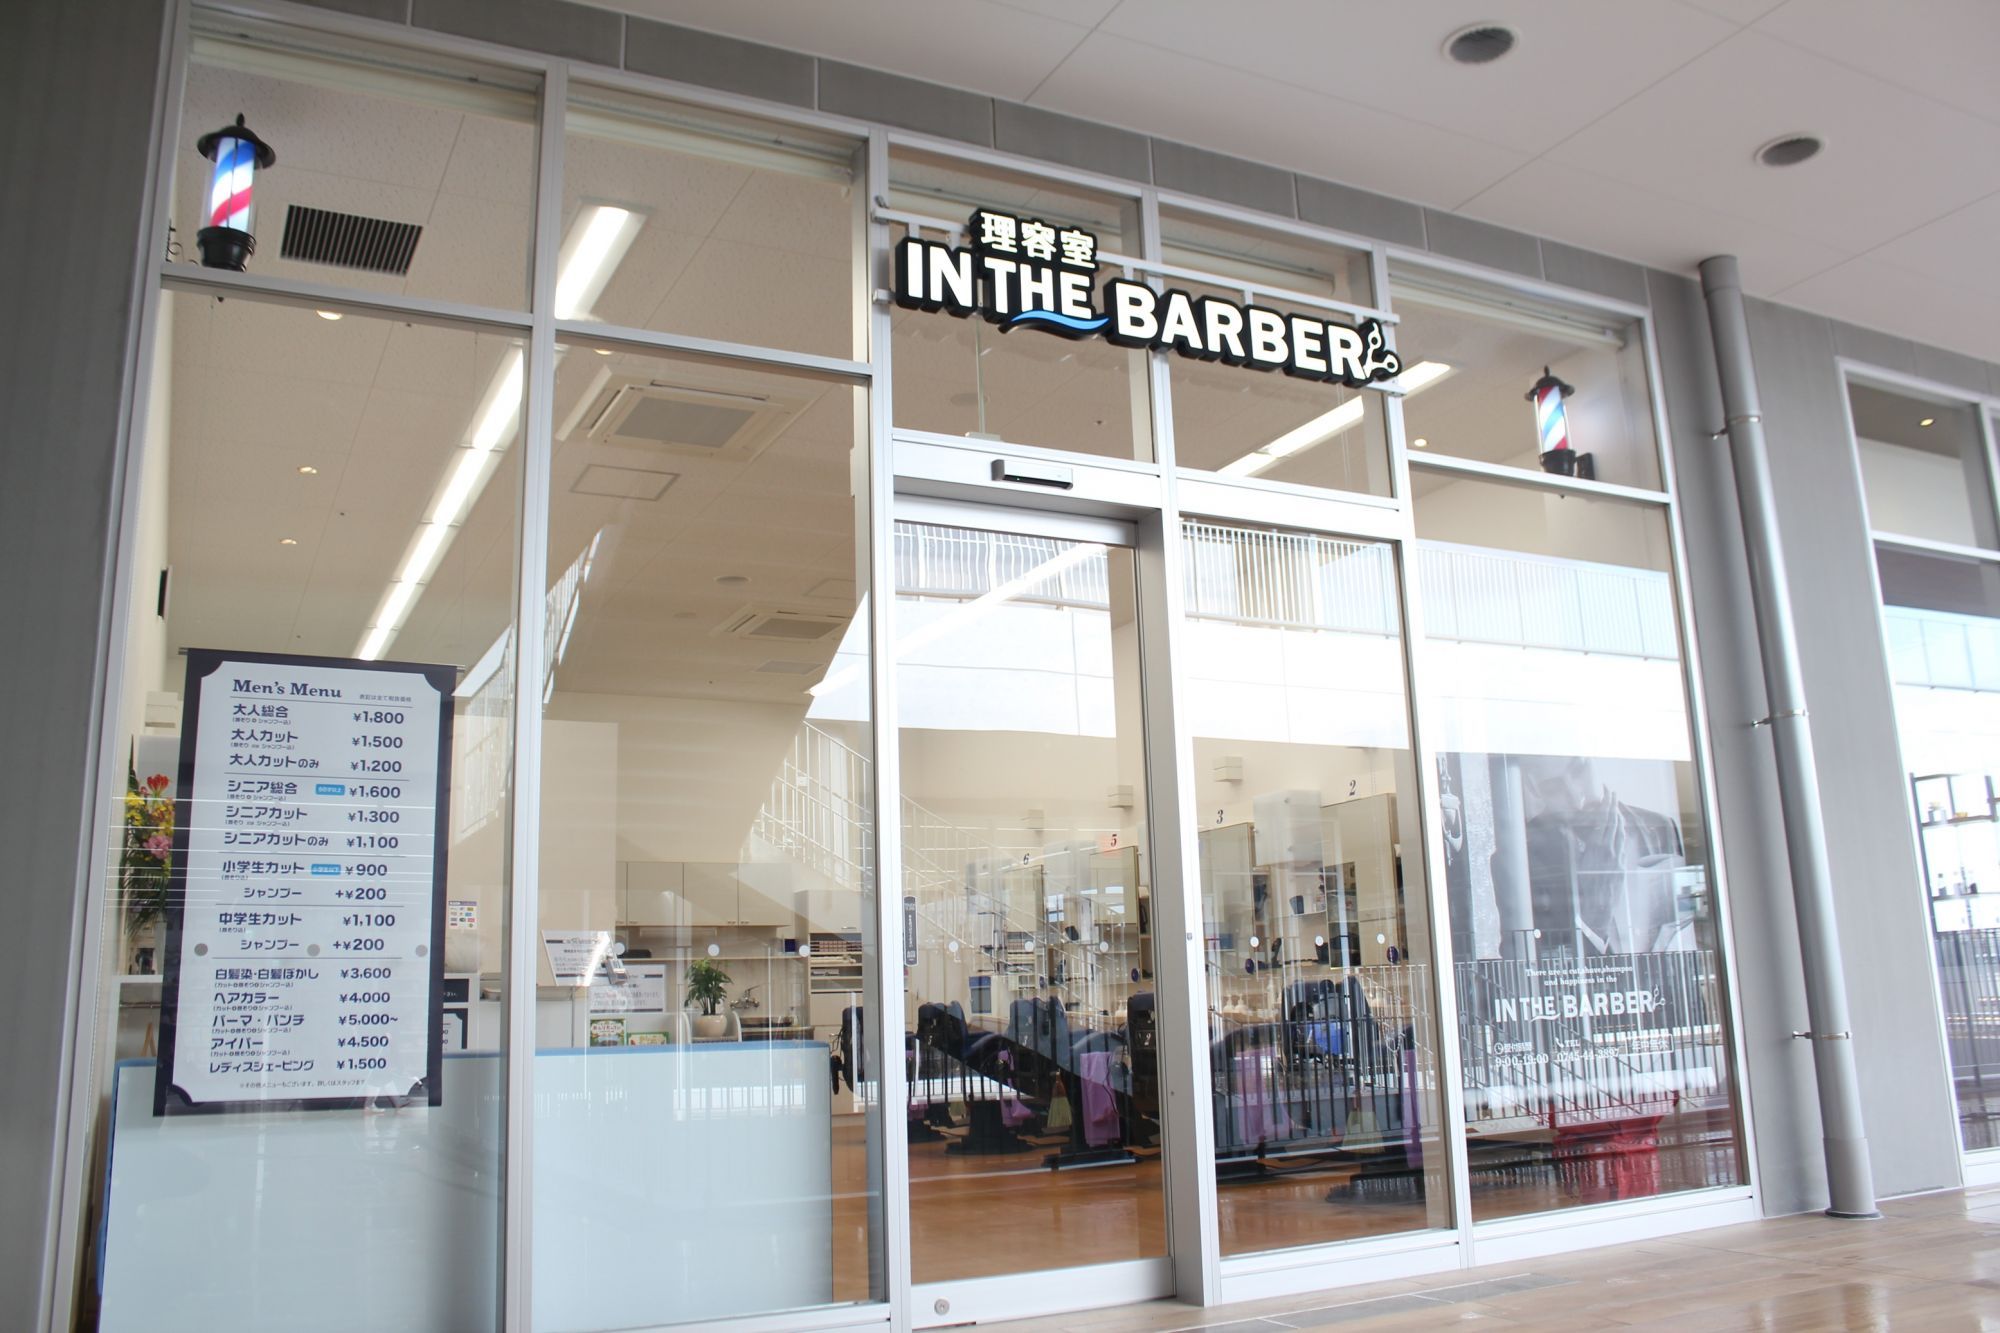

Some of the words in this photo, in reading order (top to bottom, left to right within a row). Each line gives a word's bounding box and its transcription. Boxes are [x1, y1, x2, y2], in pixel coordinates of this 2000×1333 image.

[980, 211, 1095, 269] 理容室
[906, 241, 972, 308] IN
[984, 259, 1093, 320] THE
[1115, 281, 1367, 380] BARBER
[232, 679, 285, 695] Men's
[290, 682, 342, 698] Menu
[233, 703, 289, 718] 大人総合
[352, 711, 404, 725] ¥1,800
[231, 729, 298, 743] 大人カット
[352, 735, 403, 749] ¥1,500
[229, 754, 319, 769] 大人カットのみ
[350, 759, 402, 773] ¥1,200
[227, 780, 298, 795] シニア総合
[349, 786, 401, 799] ¥1,600
[1349, 780, 1356, 796] 2
[226, 805, 308, 820] シニアカット
[348, 810, 400, 823] ¥1,300
[1216, 809, 1224, 824] 3
[224, 832, 328, 847] シニアカットのみ
[346, 836, 398, 849] ¥1,100
[1111, 834, 1117, 847] 5
[1023, 853, 1030, 865] 6
[222, 860, 304, 874] 小学生カット
[243, 887, 302, 899] シャンプー
[335, 888, 387, 900] +¥200
[219, 912, 302, 926] 中学生カット
[343, 914, 396, 927] ¥1,100
[240, 938, 299, 950] シャンプー
[332, 939, 384, 951] +¥200
[340, 967, 392, 979] ¥3,600
[1525, 968, 1546, 976] There
[1544, 978, 1558, 986] and
[1606, 975, 1617, 983] the
[214, 992, 279, 1004] ヘアカラー
[339, 992, 391, 1004] ¥4,000
[1495, 998, 1517, 1022] IN
[1519, 995, 1556, 1021] THE
[1562, 990, 1654, 1018] BARBER
[337, 1035, 389, 1048] ¥4,500
[1565, 1040, 1580, 1048] TEL
[337, 1058, 387, 1070] ¥1,500
